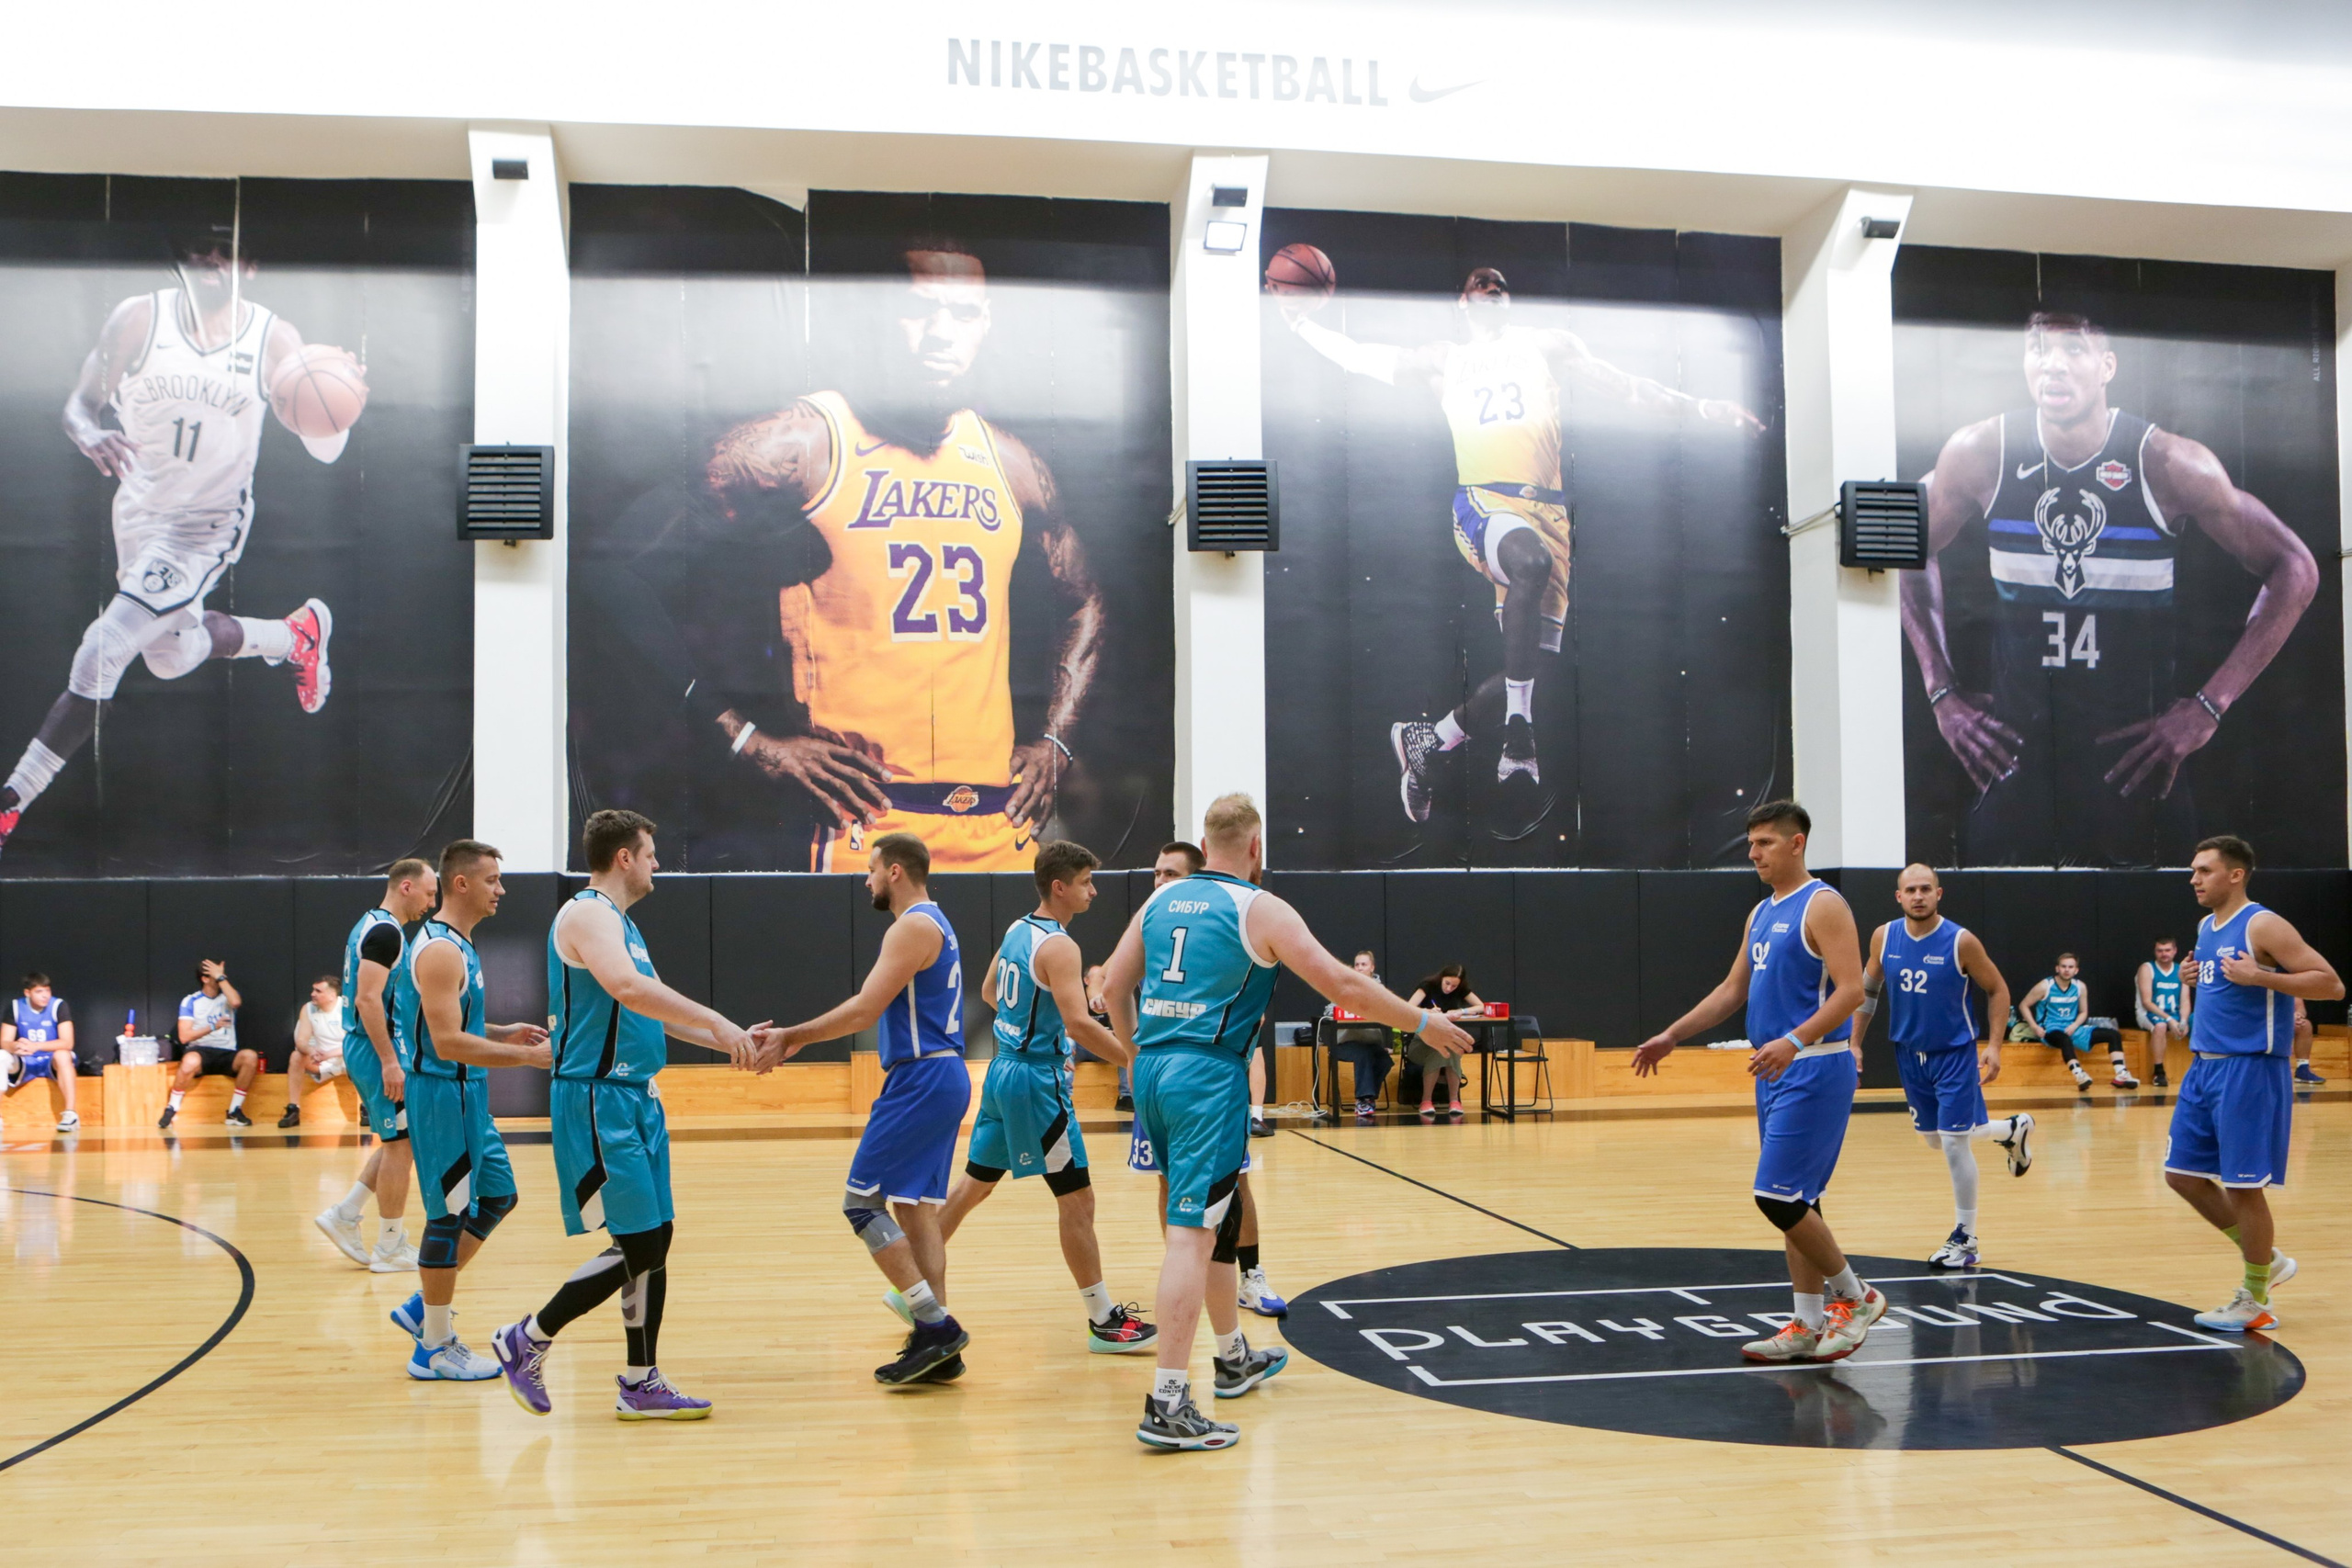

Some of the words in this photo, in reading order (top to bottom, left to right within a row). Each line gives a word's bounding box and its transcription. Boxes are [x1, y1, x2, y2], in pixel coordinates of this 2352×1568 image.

[947, 37, 1389, 107] NIKEBASKETBALL
[143, 374, 252, 417] BROOKLYN
[1473, 381, 1525, 426] 23
[173, 416, 202, 463] 11
[846, 469, 1002, 532] LAKERS
[887, 542, 989, 638] 23
[2041, 612, 2101, 669] 34
[1168, 899, 1210, 915] СИБУР
[1161, 925, 1190, 985] 1
[944, 960, 963, 1035] 2
[996, 956, 1022, 1010] 00
[1899, 967, 1928, 995] 32
[2155, 993, 2177, 1013] 11
[27, 1028, 47, 1043] 69
[1132, 1137, 1154, 1167] 33
